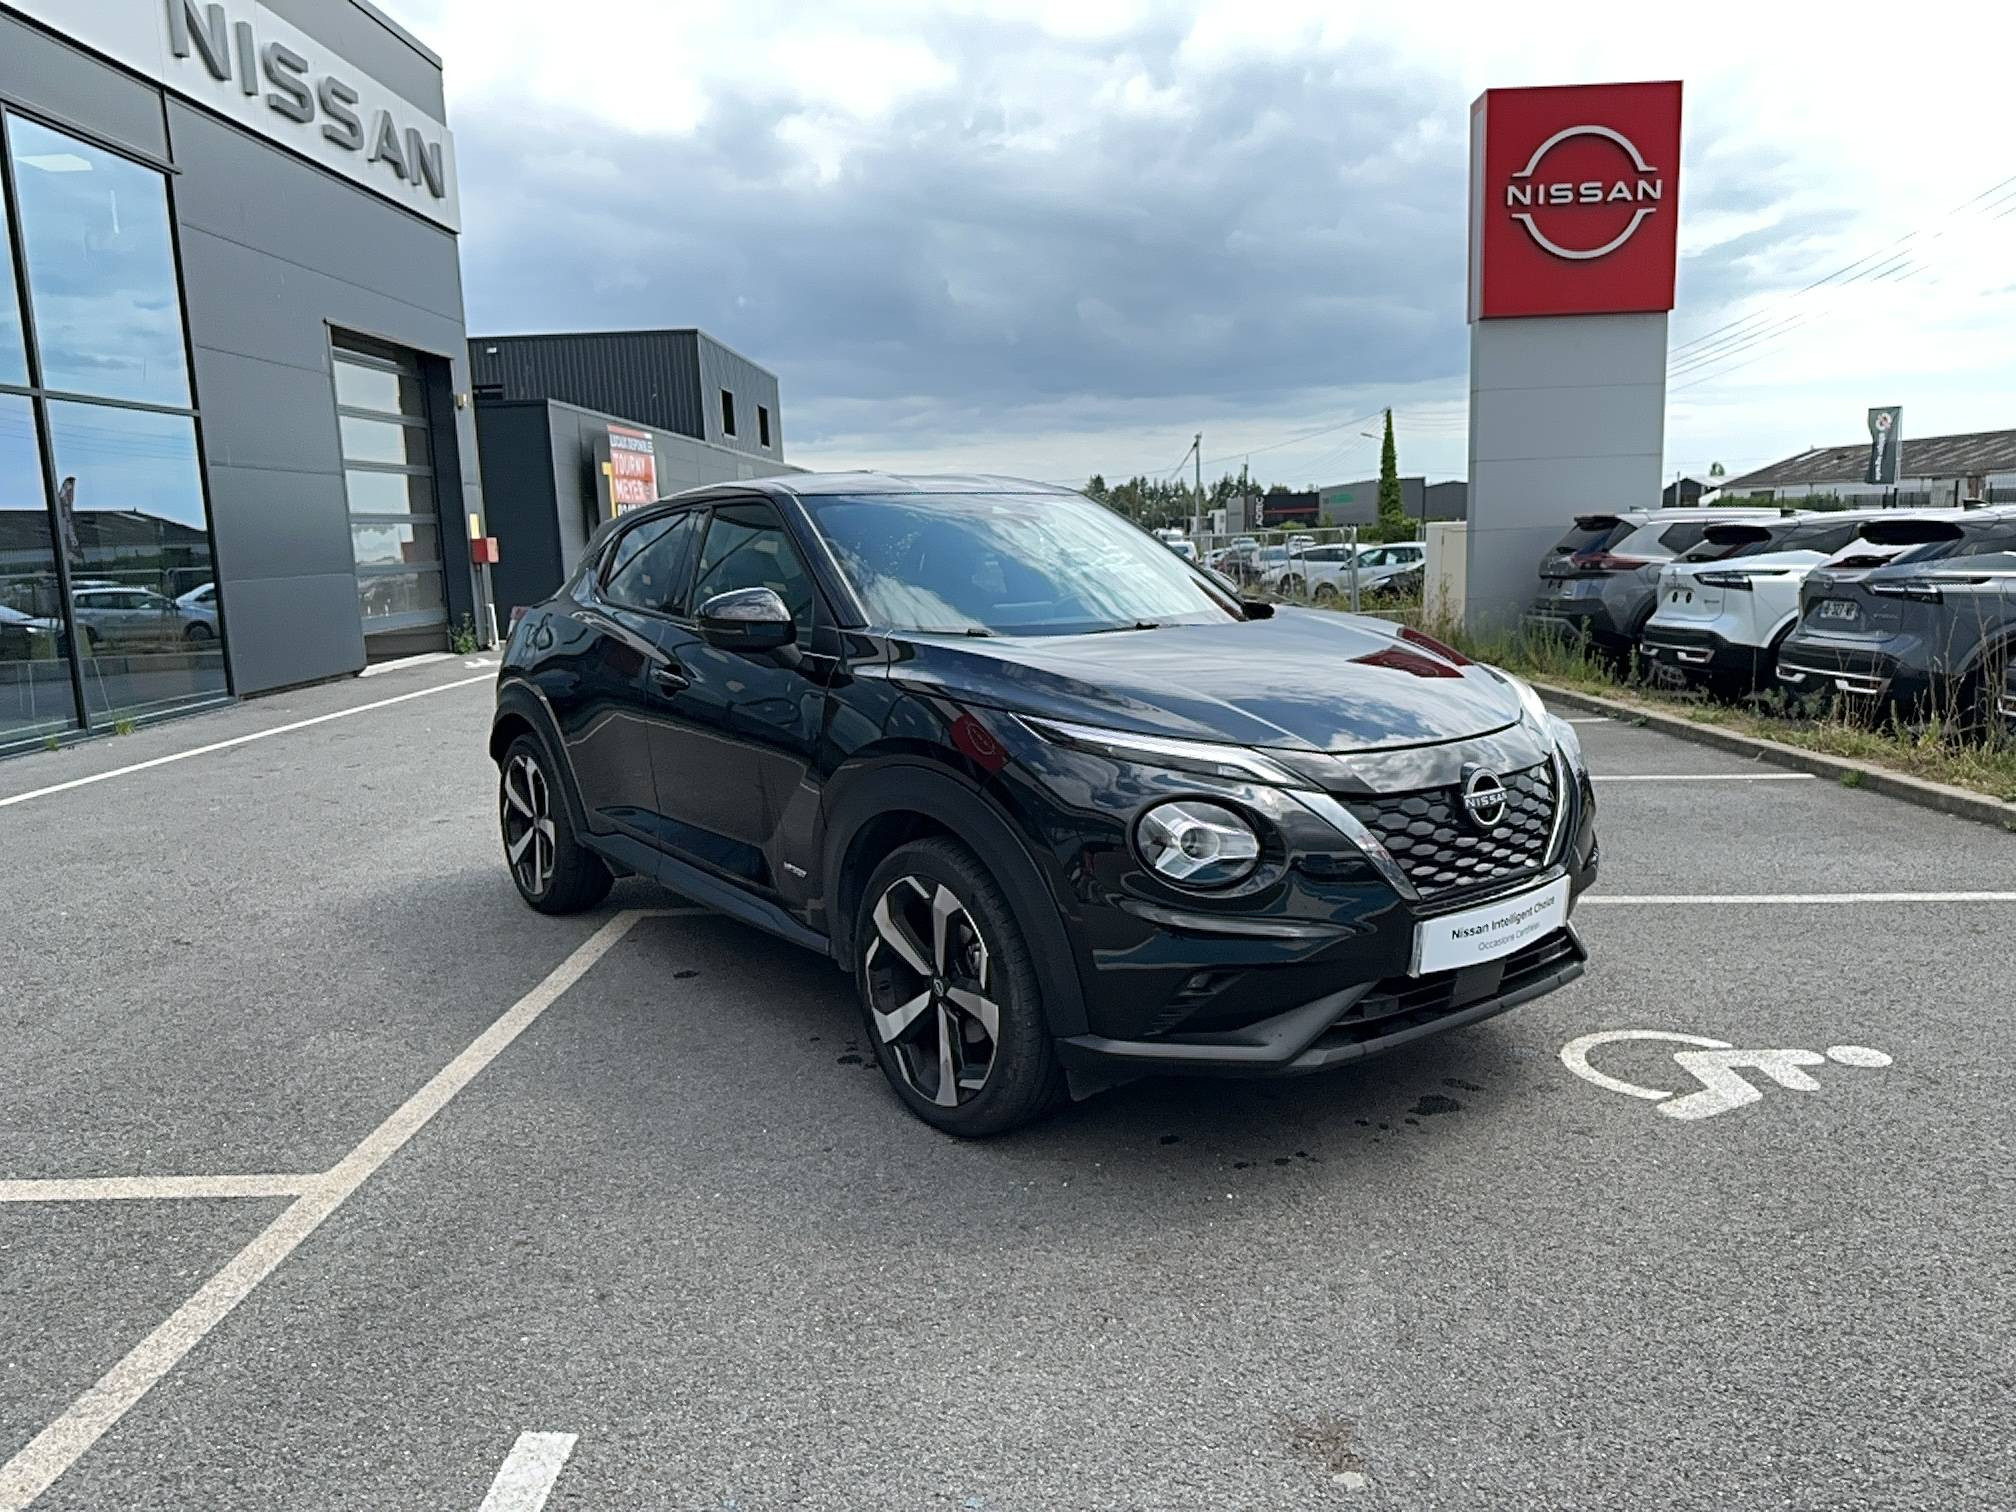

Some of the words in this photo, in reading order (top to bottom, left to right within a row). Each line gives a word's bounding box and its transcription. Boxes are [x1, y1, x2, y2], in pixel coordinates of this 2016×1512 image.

[166, 0, 445, 199] NISSAN
[1507, 178, 1663, 206] NISSAN
[1464, 791, 1508, 810] NISSAN
[1451, 922, 1490, 941] Nissan
[1491, 906, 1533, 931] Intelligent
[1478, 934, 1515, 952] Occasions
